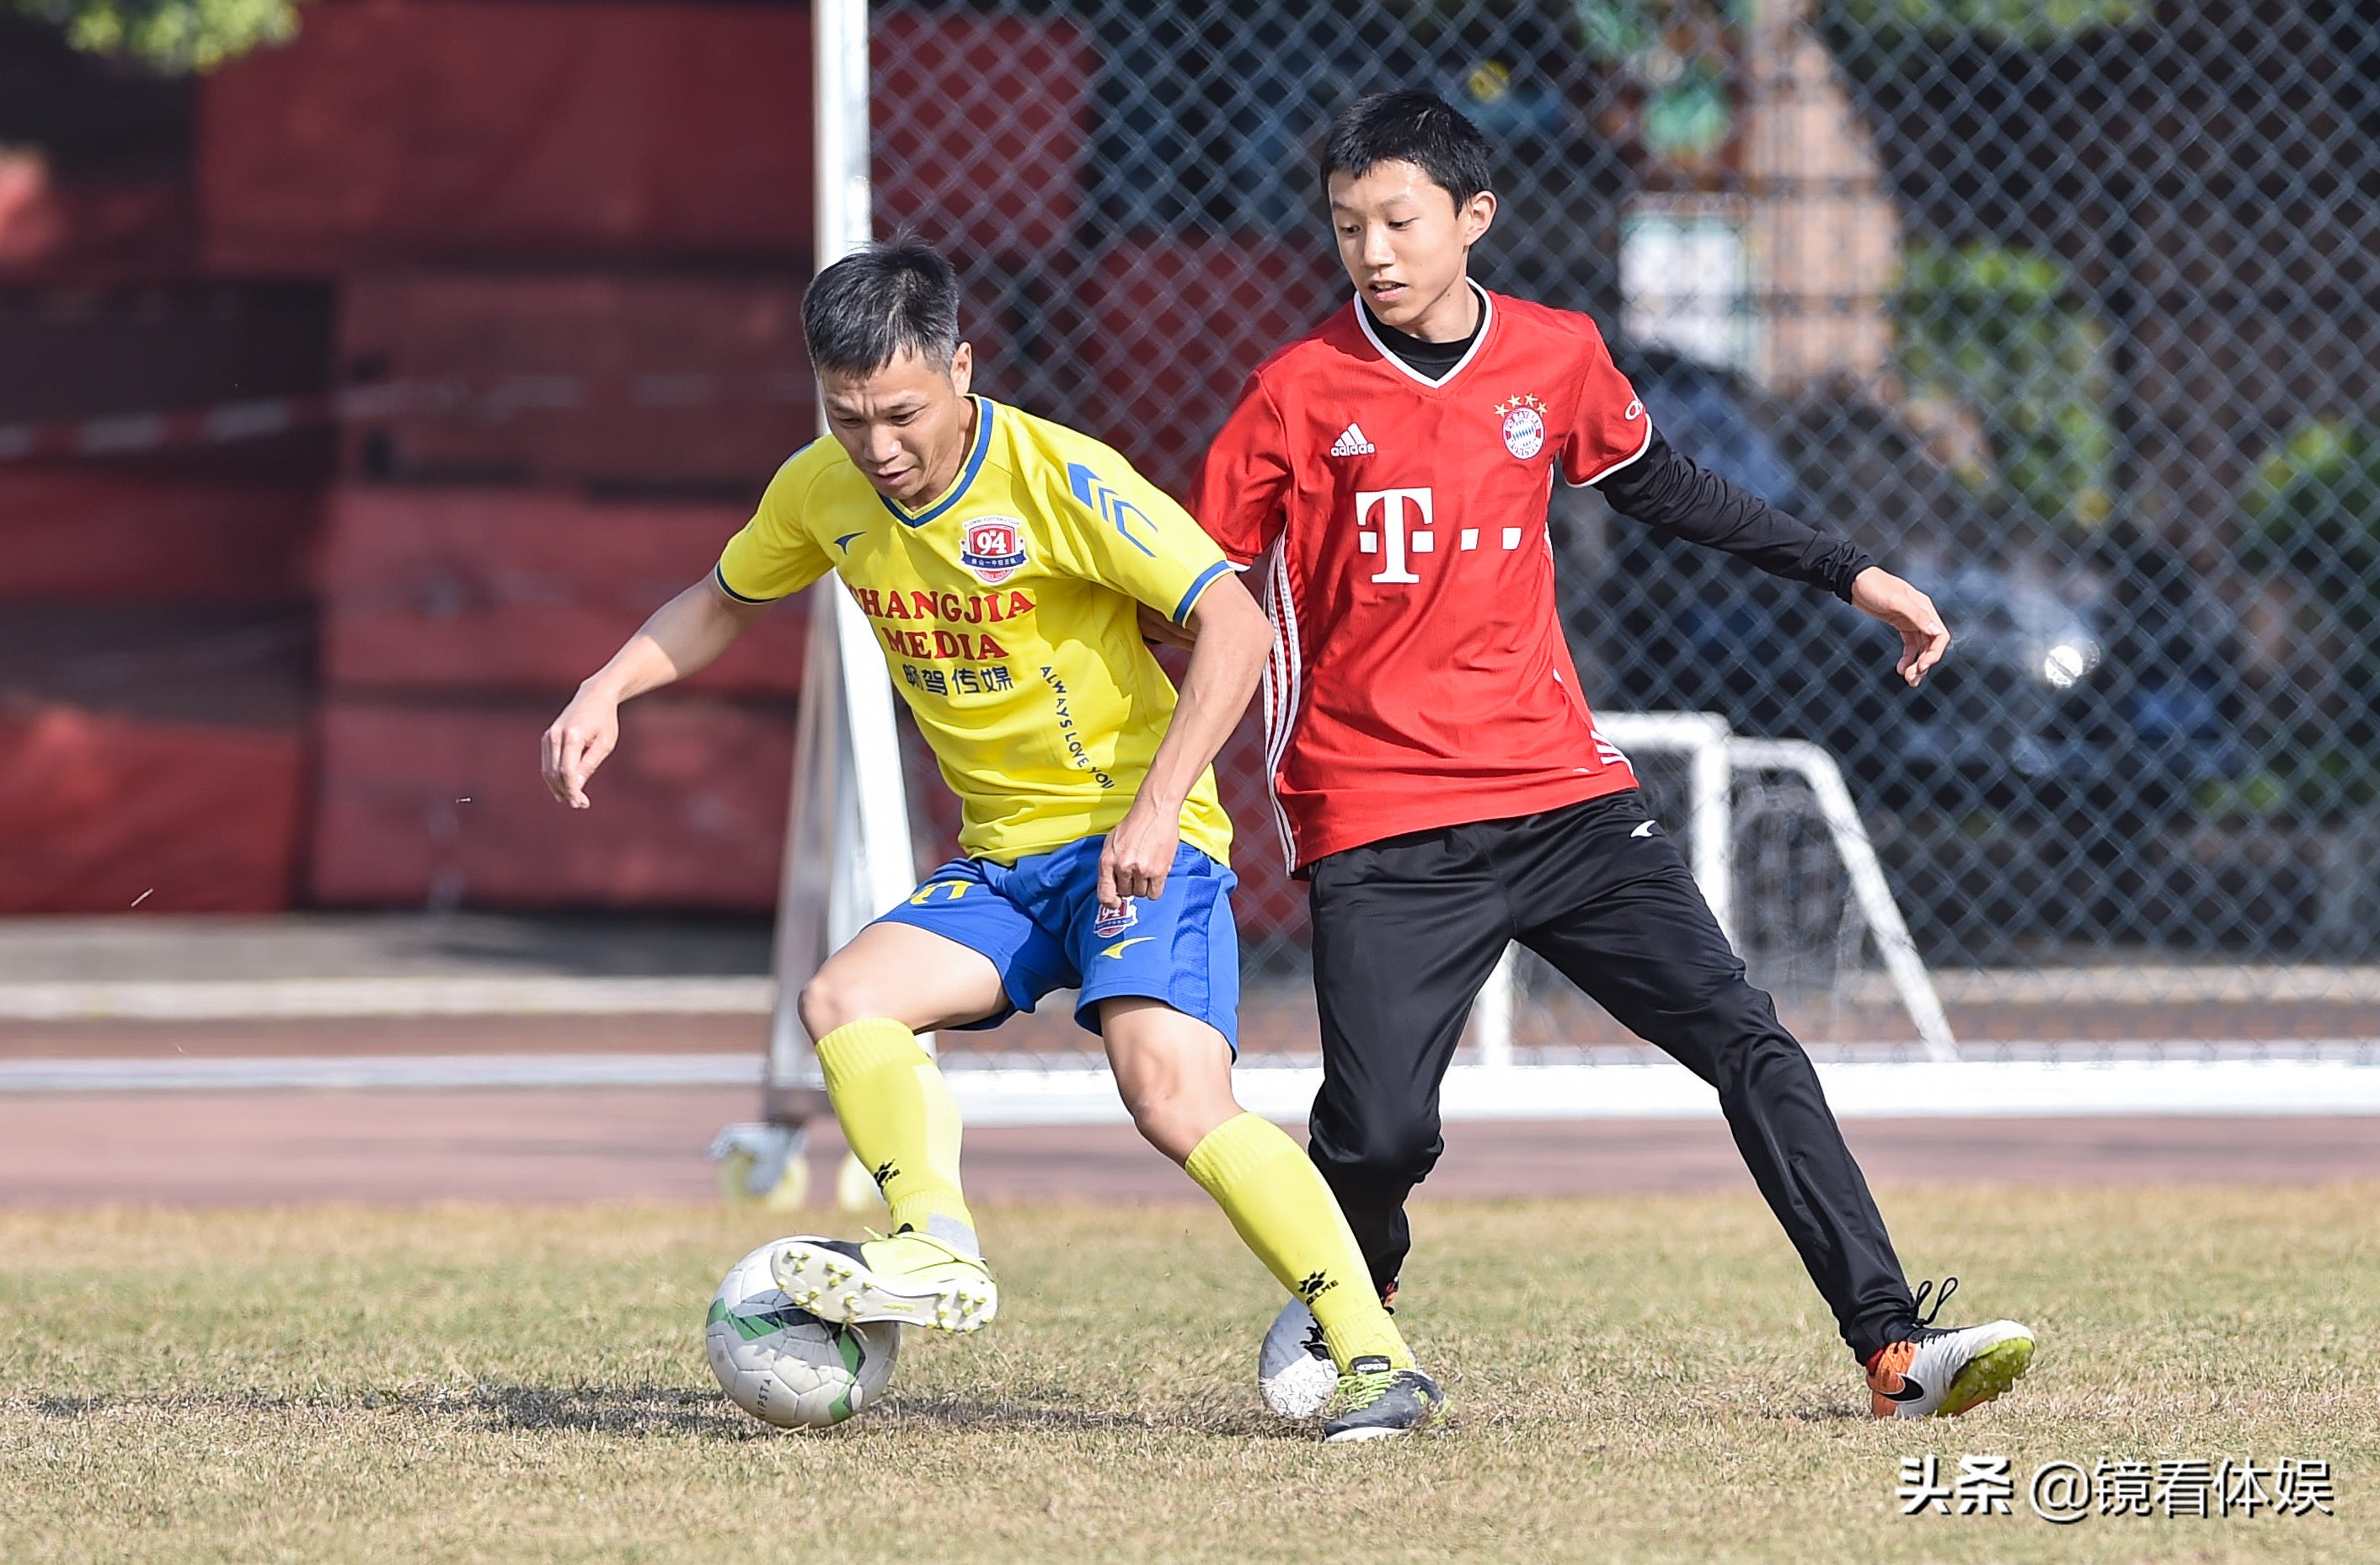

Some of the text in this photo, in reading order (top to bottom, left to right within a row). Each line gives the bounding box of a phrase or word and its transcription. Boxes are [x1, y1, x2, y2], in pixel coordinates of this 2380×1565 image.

[1330, 443, 1375, 457] adidas
[976, 531, 1008, 555] 94
[881, 627, 1009, 660] MEDIA
[1040, 666, 1115, 789] ALWAYS LOVE YOU
